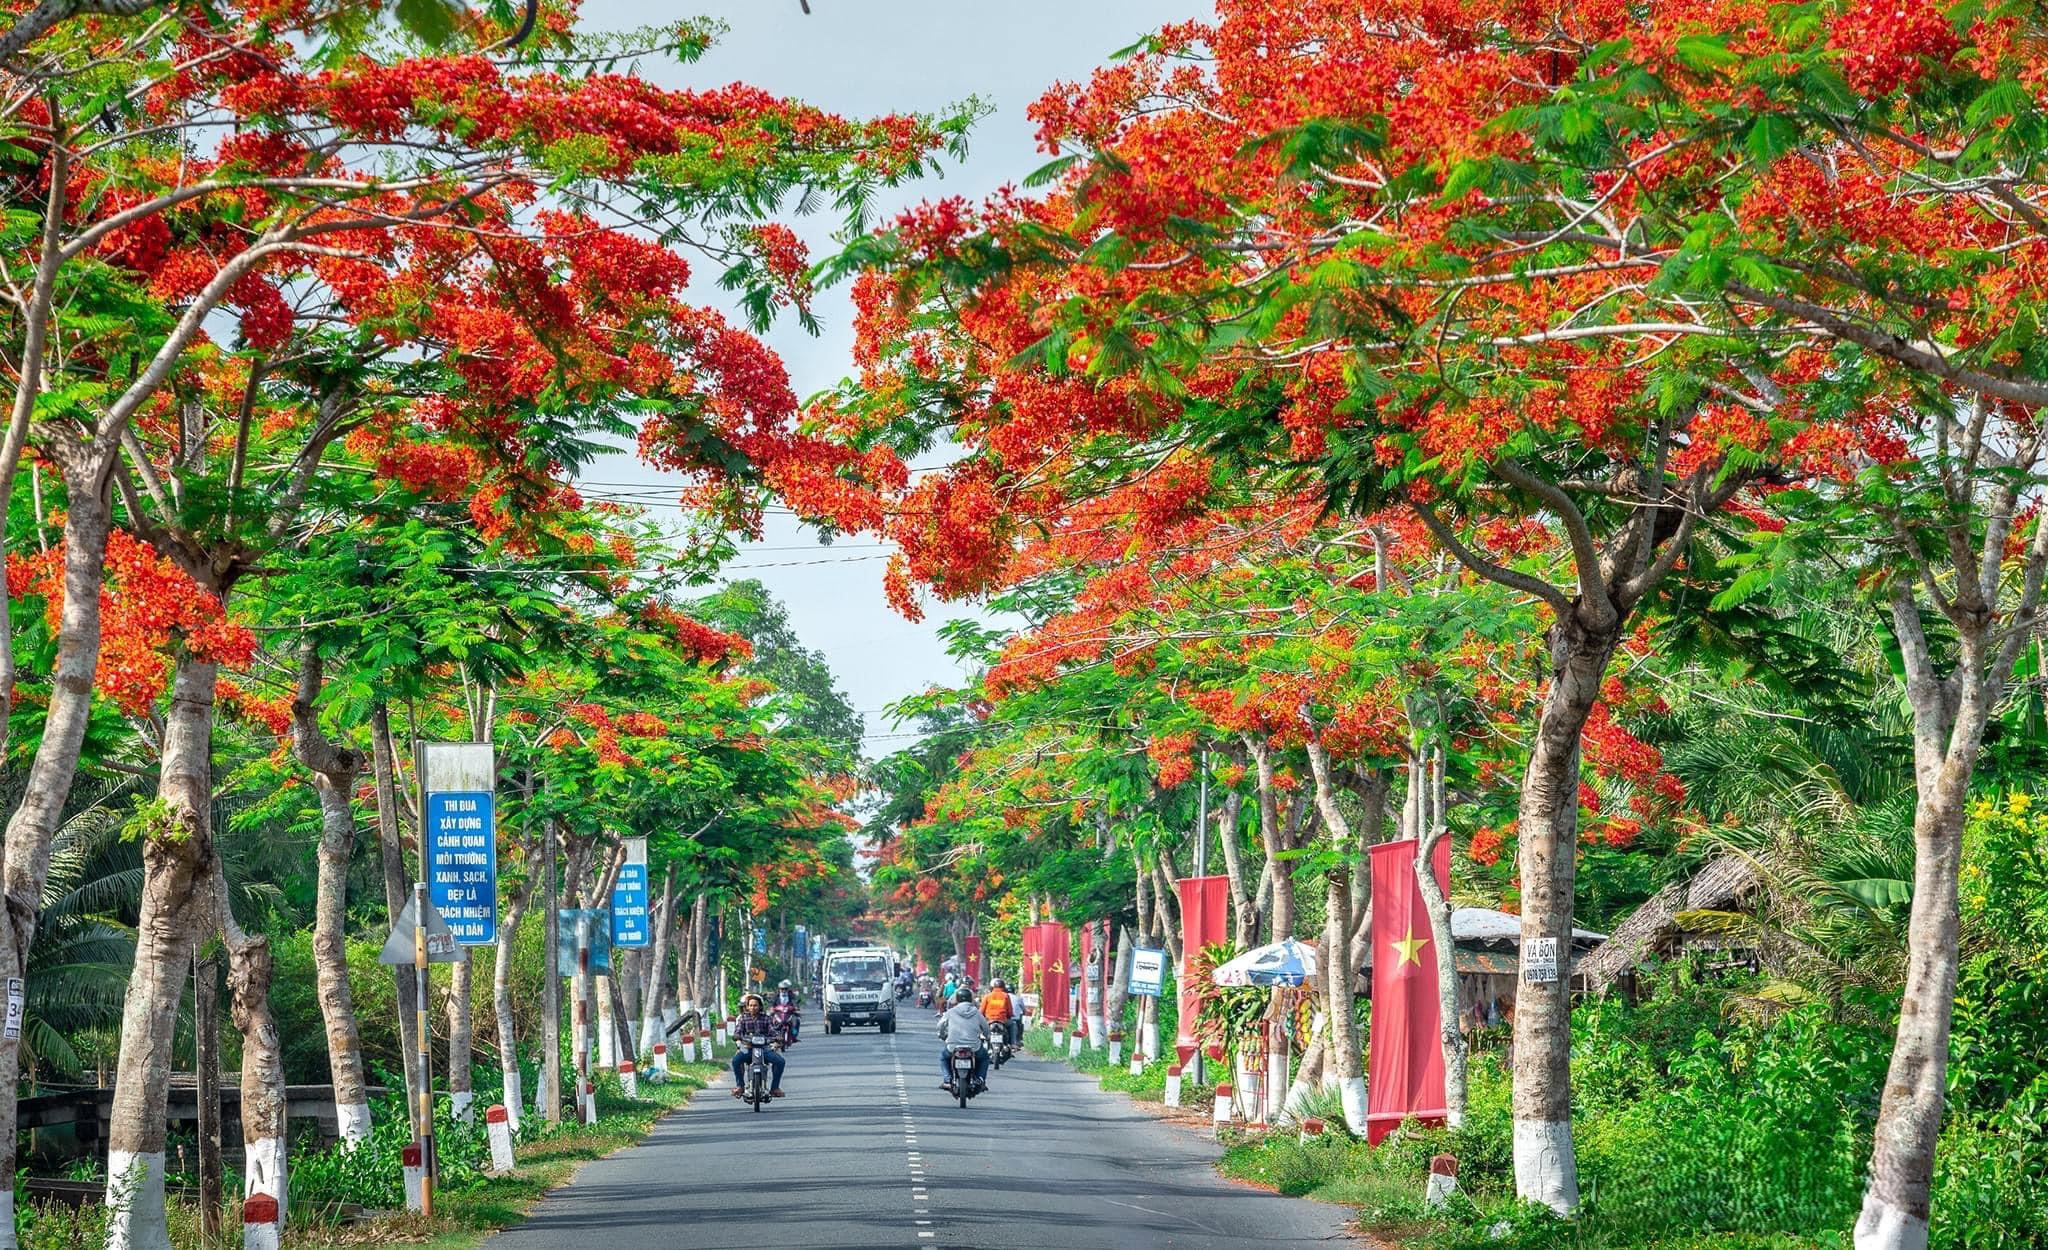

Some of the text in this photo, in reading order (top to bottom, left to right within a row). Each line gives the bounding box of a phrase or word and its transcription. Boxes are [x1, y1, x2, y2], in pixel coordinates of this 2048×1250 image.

[444, 799, 477, 812] THI ĐUA
[440, 815, 482, 832] XÂY DỰNG
[437, 831, 485, 849] CẢNH QUAN
[435, 850, 488, 865] MÔI TRƯỜNG
[447, 886, 477, 903] ĐẸP LÀ
[463, 904, 491, 921] NHIỆM
[466, 922, 484, 937] DÂN
